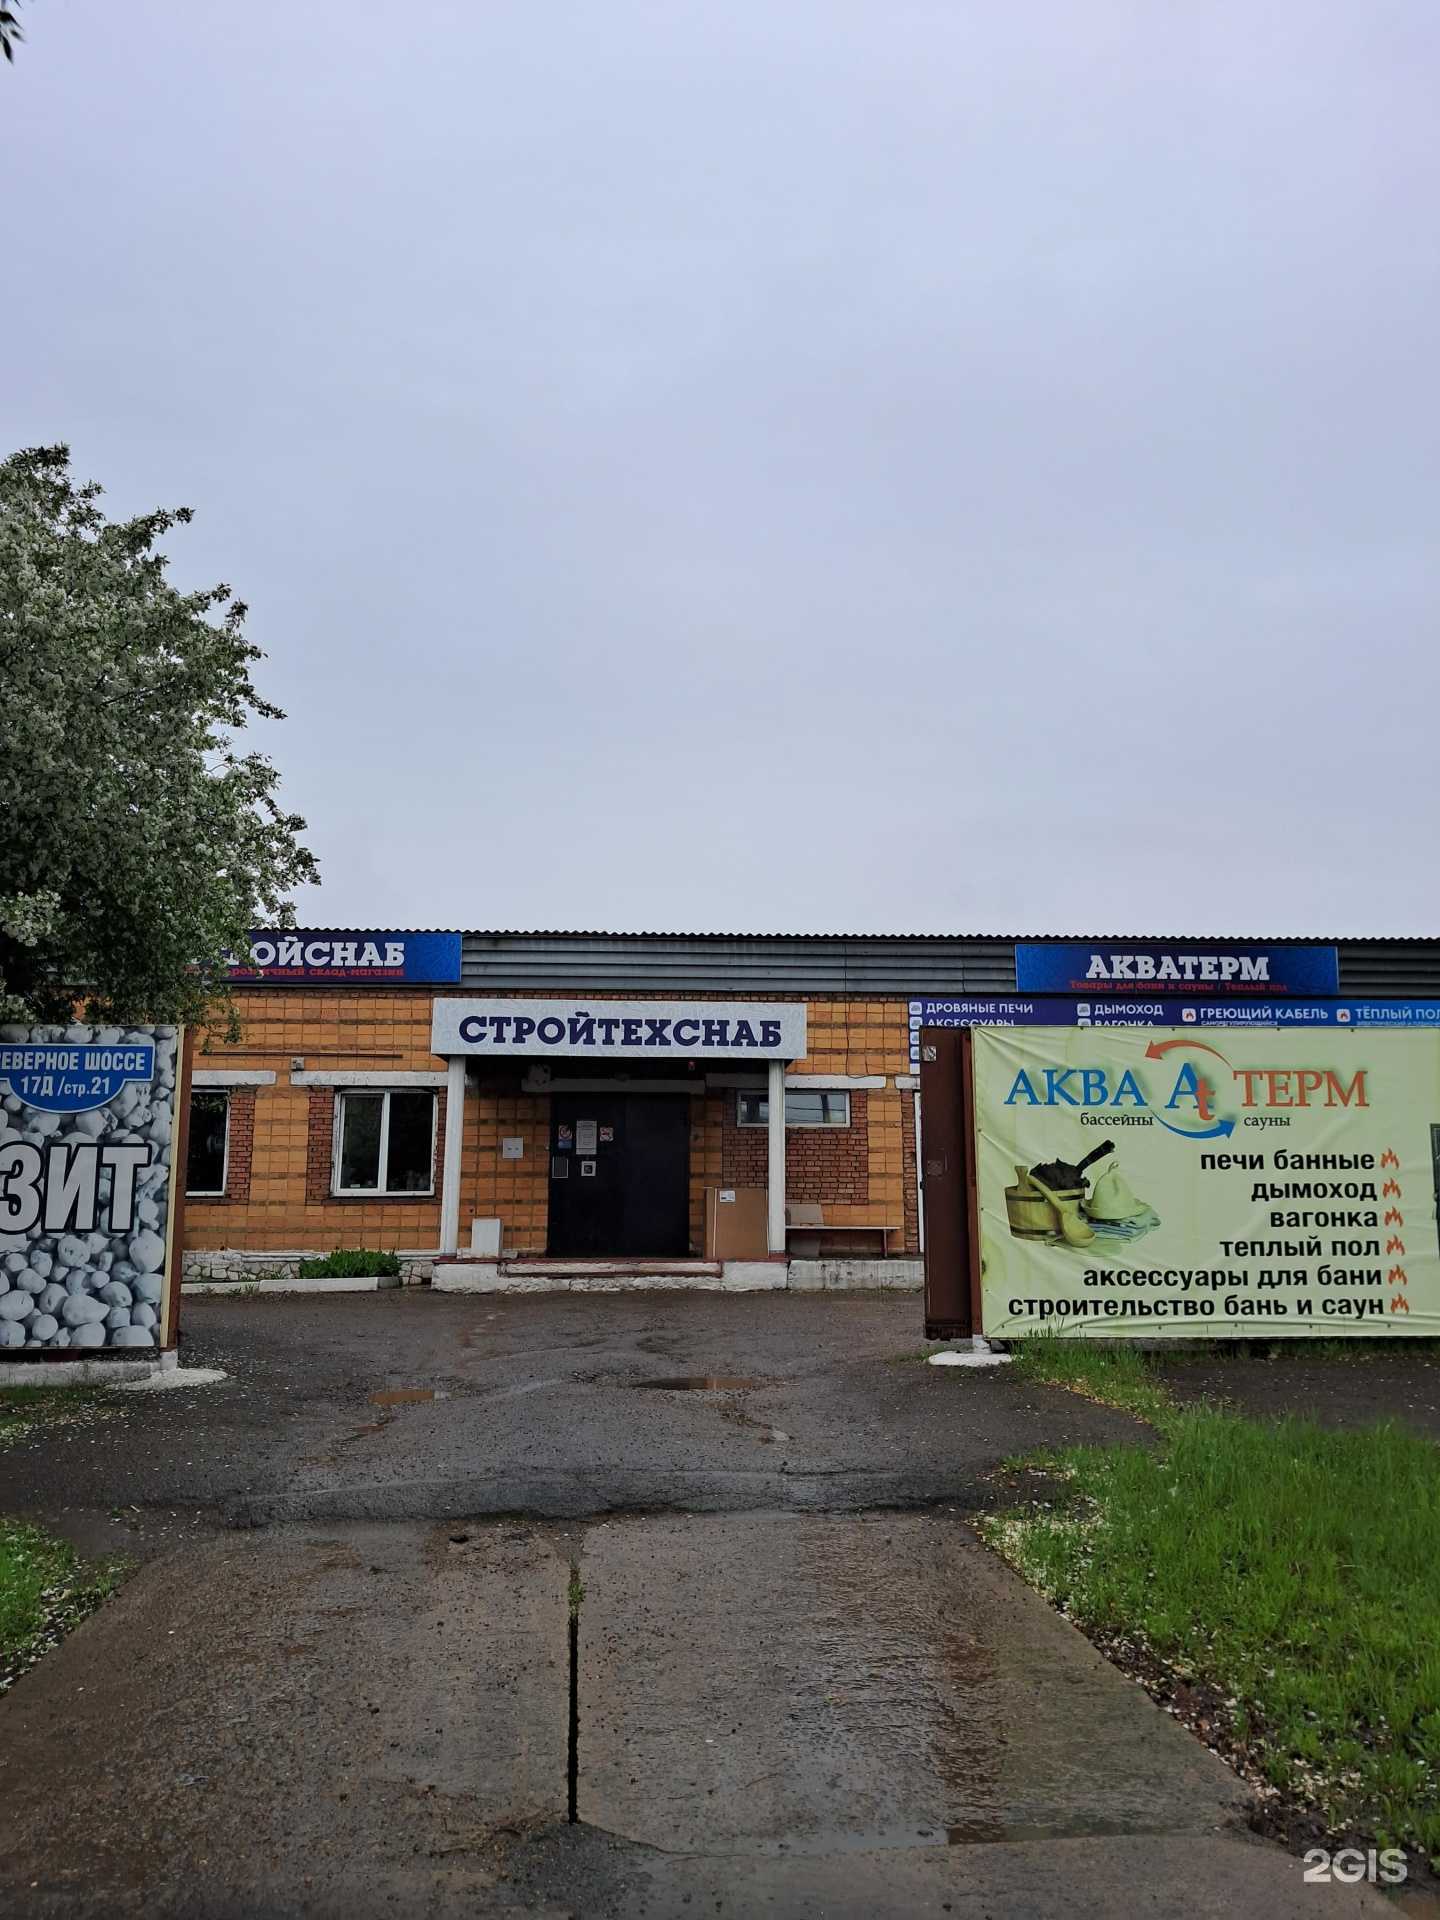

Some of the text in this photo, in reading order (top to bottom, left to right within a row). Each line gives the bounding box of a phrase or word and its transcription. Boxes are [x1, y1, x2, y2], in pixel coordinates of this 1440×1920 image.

[192, 936, 405, 967] ОЙСНАБ
[1086, 954, 1270, 981] АКВАТЕРМ
[926, 1003, 1033, 1014] ДРОВЯНЫЕ ПЕЧИ
[1094, 1004, 1163, 1016] ДЫМОХОД
[1200, 1006, 1328, 1020] ГРЕЮЩИЙ КАБЕЛЬ
[1355, 1006, 1412, 1019] ТЁПЛЫЙ
[459, 1011, 782, 1048] СТРОЙТЕХСНАБ
[0, 1051, 145, 1071] ЕВЕРНОЕ ШОССЕ
[21, 1076, 54, 1096] 17Д
[1004, 1068, 1148, 1107] АКВА
[1233, 1070, 1369, 1107] ТЕРМ
[1080, 1112, 1154, 1127] бассейны
[1243, 1116, 1291, 1130] сауны
[1200, 1149, 1375, 1170] печи банные
[1251, 1180, 1377, 1202] дымоход
[1270, 1209, 1378, 1227] вагонка
[1220, 1236, 1380, 1257] теплый пол
[1083, 1265, 1382, 1291] аксессуары для бани
[1008, 1296, 1384, 1320] строительство бань и саун
